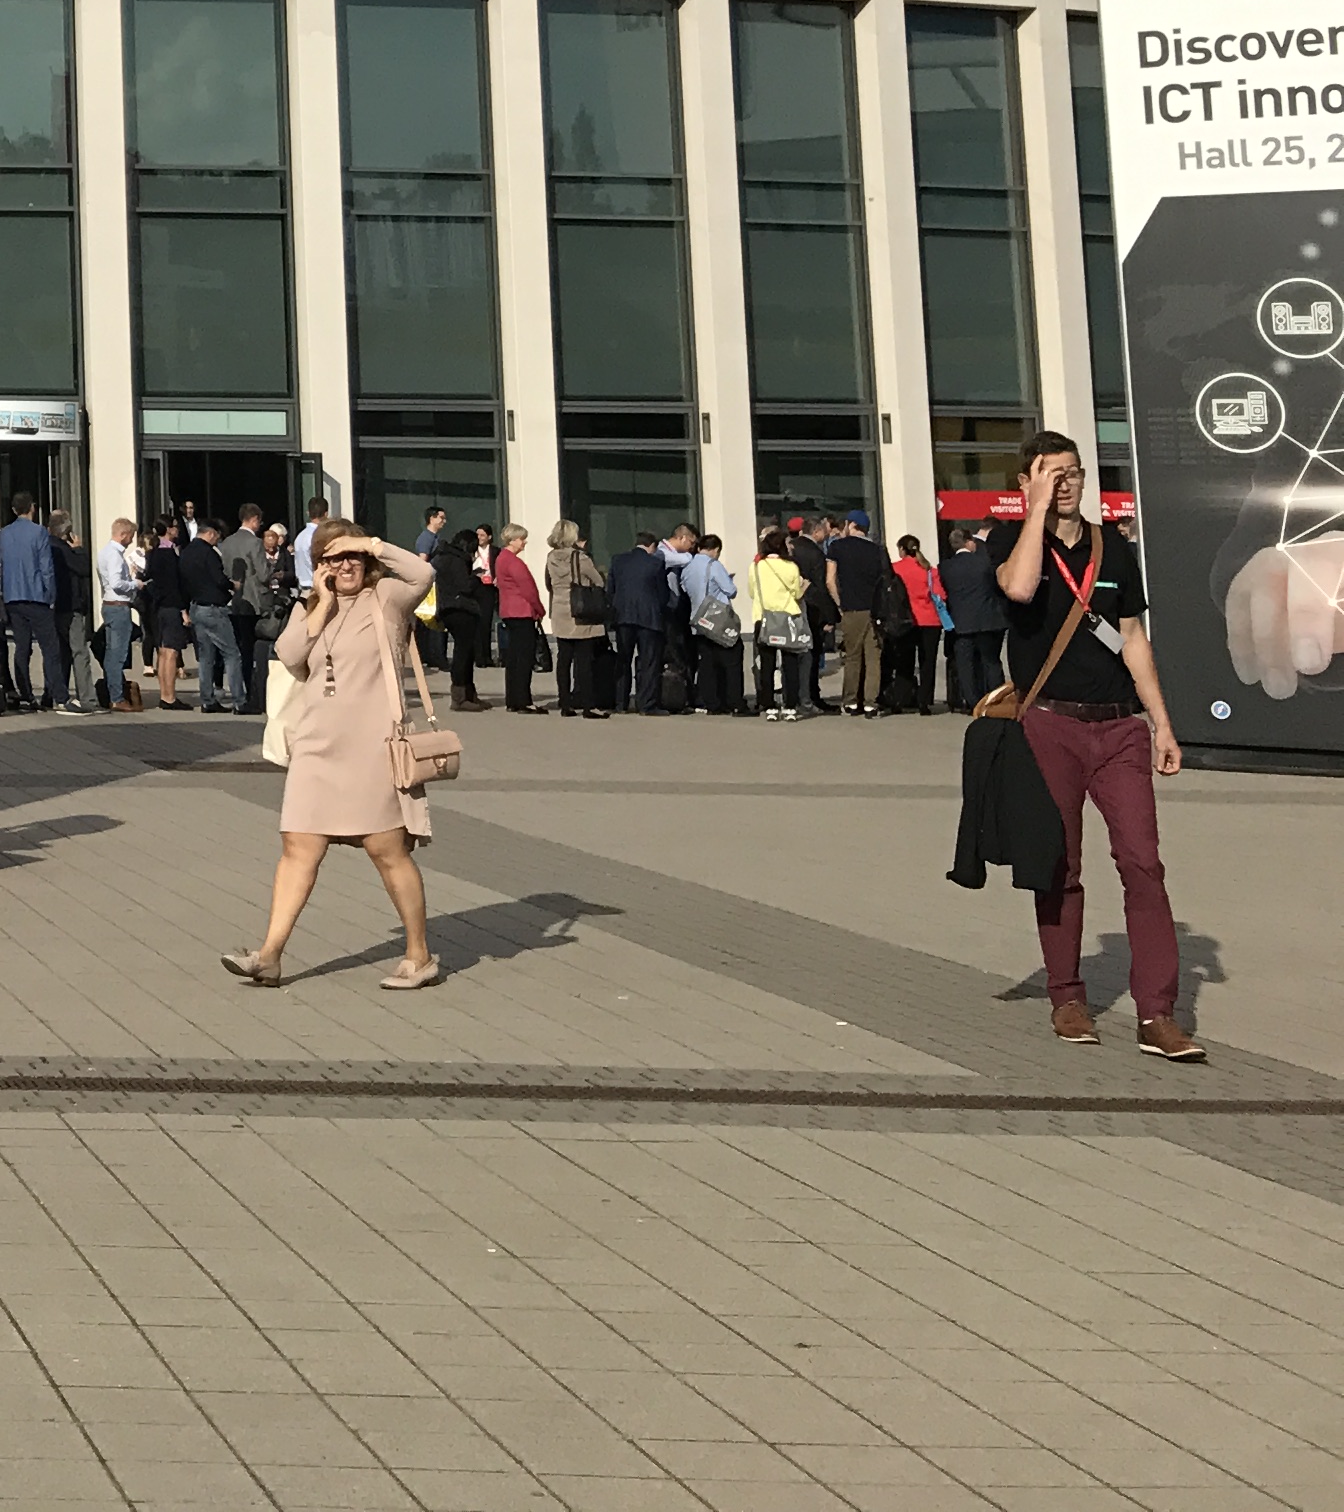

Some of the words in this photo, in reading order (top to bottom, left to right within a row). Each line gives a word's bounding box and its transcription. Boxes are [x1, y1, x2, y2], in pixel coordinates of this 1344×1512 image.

[1138, 25, 1344, 68] Discover
[1143, 81, 1223, 124] ICT
[1178, 138, 1252, 170] Hall
[1262, 135, 1316, 169] 25,
